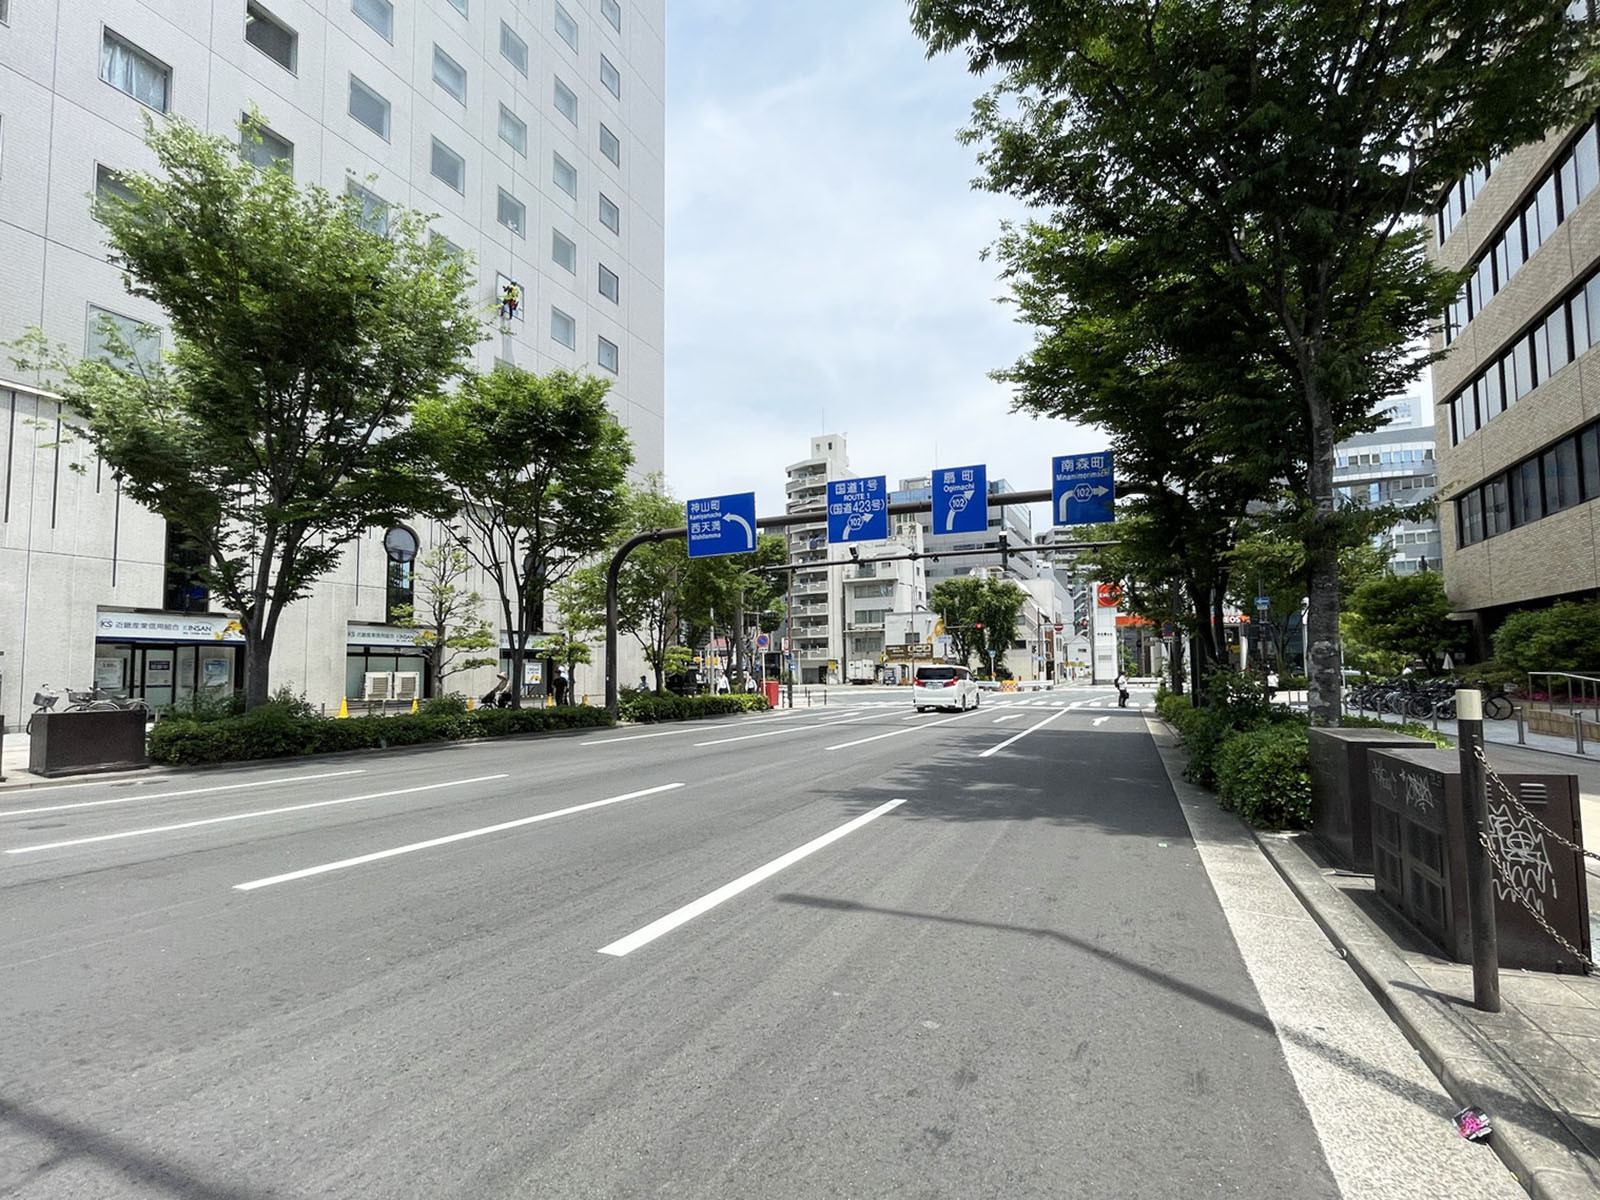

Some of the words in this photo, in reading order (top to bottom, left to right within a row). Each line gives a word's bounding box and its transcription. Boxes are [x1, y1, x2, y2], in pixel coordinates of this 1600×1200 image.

[1061, 456, 1104, 473] 南森町
[943, 470, 974, 484] 扇町
[835, 479, 878, 495] 国道1号
[943, 482, 975, 493] Ogimachi
[1076, 487, 1091, 497] 102
[843, 493, 865, 501] ROUTE
[690, 500, 720, 513] 神山町
[952, 499, 965, 508] 102
[691, 520, 721, 534] 西天満
[850, 517, 862, 526] 102
[100, 620, 112, 629] KS
